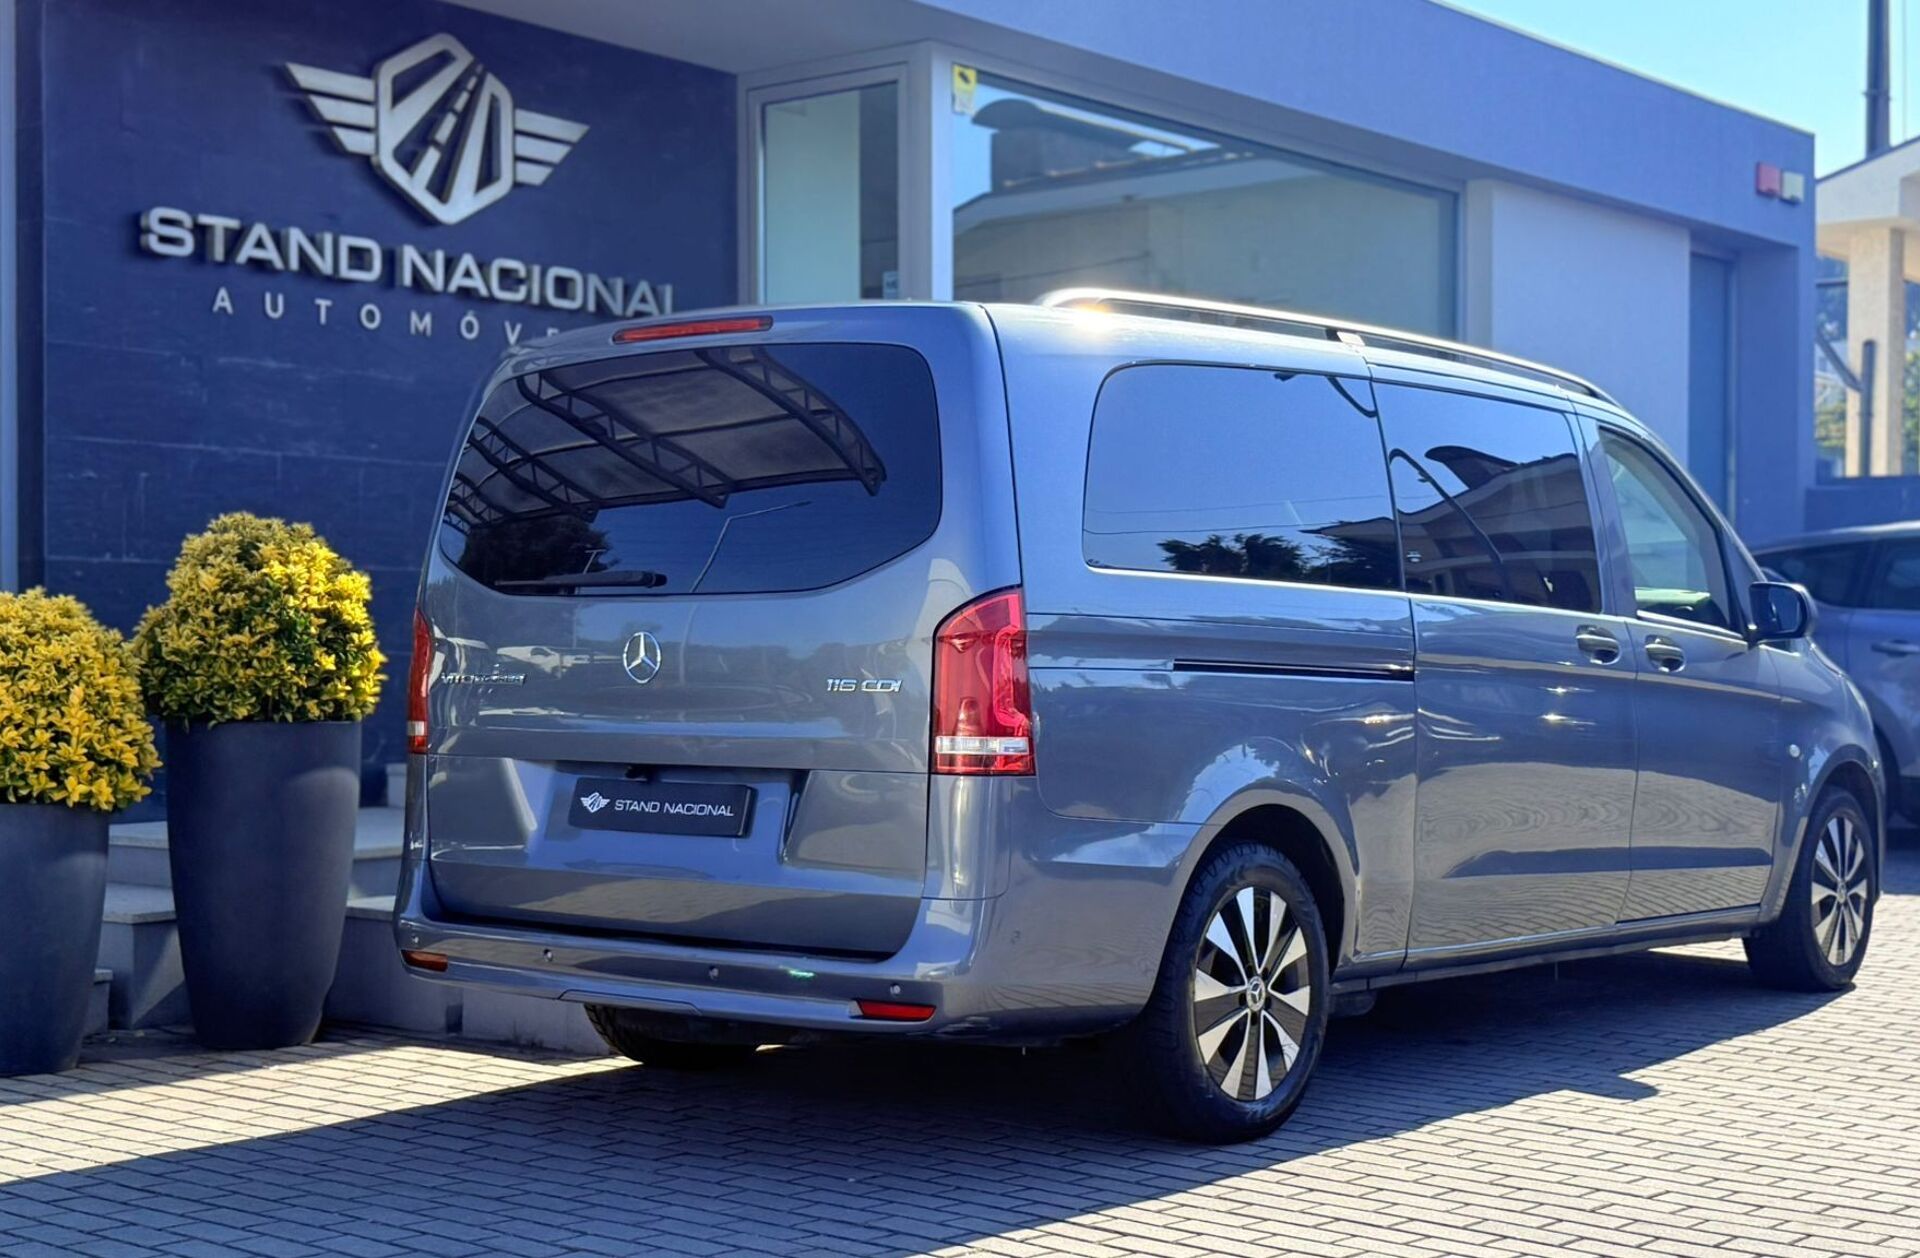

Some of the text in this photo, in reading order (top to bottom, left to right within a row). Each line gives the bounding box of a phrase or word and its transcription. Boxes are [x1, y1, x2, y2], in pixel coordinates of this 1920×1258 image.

[141, 206, 381, 281] STAND
[614, 799, 734, 816] STAND NACIONAL
